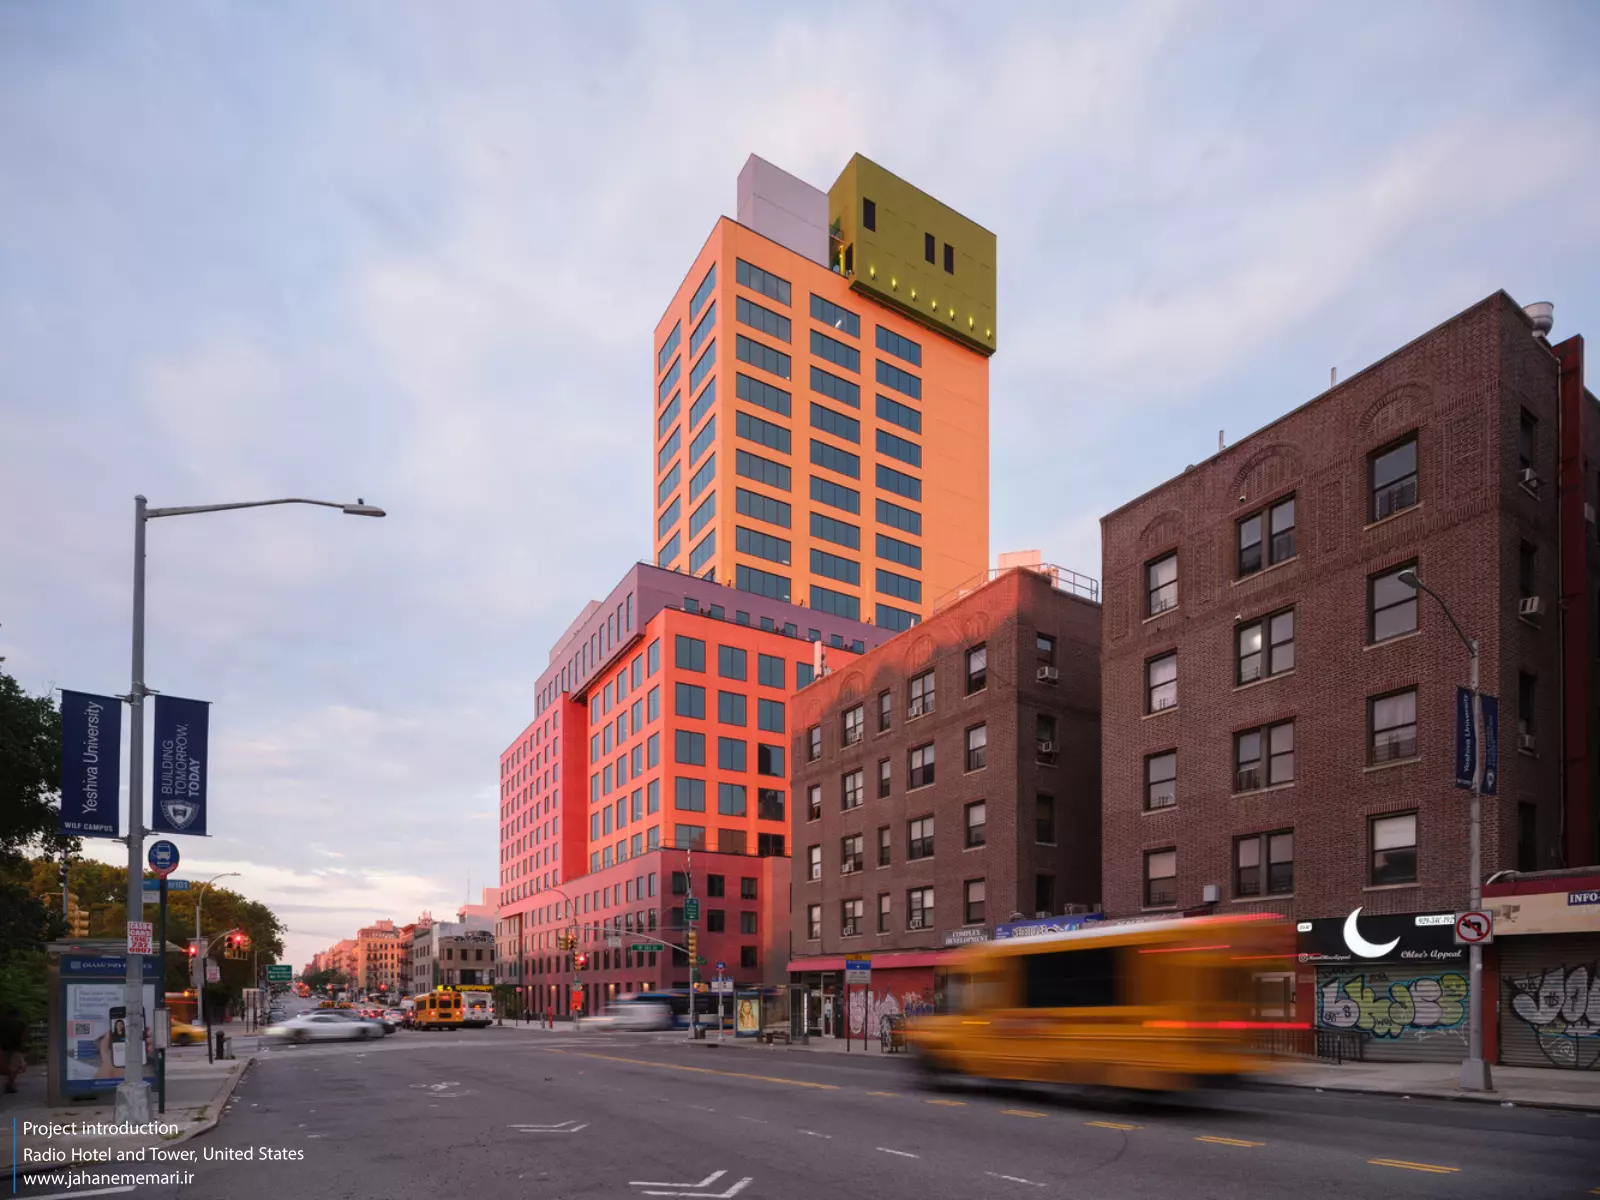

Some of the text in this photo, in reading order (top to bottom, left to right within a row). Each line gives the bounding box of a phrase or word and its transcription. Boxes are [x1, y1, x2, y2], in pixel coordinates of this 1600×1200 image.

[82, 701, 103, 814] Yeshiva University
[161, 740, 174, 794] BUILDING
[188, 757, 200, 798] TODAY
[64, 821, 113, 832] WILF CAMPUS
[1401, 949, 1462, 959] Chloe's Appeal
